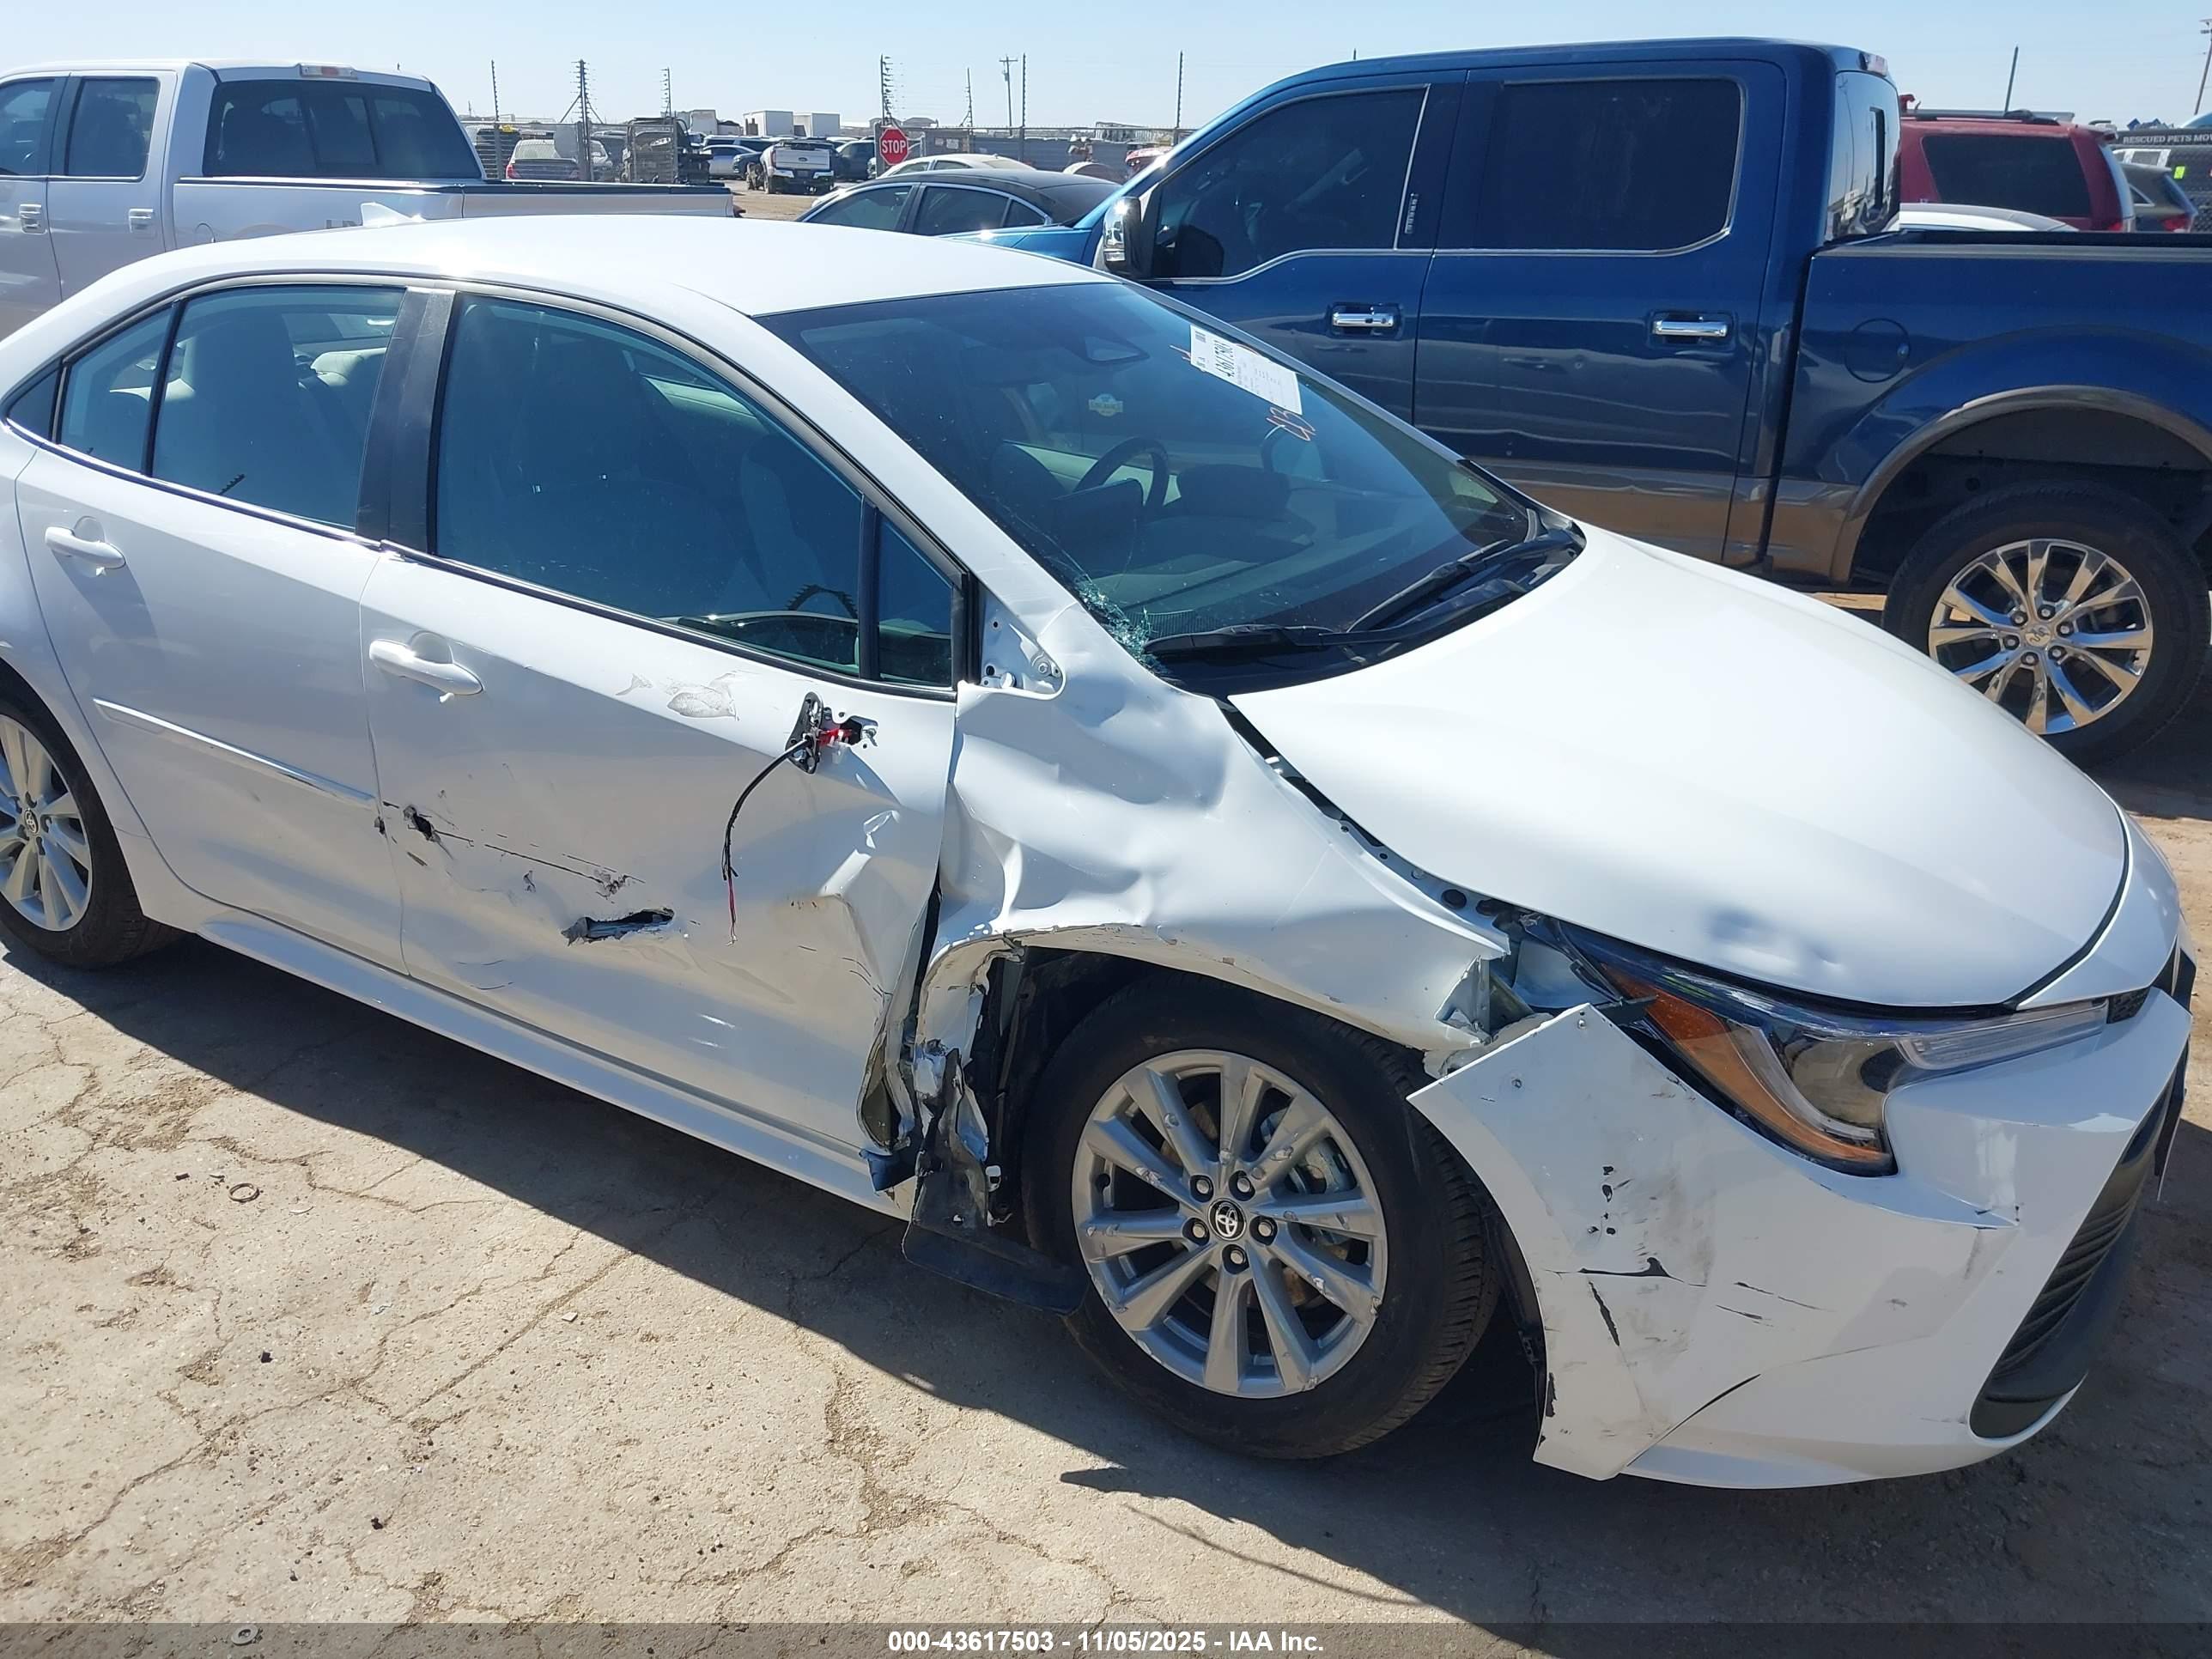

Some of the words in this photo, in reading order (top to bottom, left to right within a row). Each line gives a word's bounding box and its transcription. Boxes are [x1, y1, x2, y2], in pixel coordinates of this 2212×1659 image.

[2123, 136, 2166, 145] RESCUED
[2167, 135, 2192, 143] PETS
[882, 140, 906, 154] STOP
